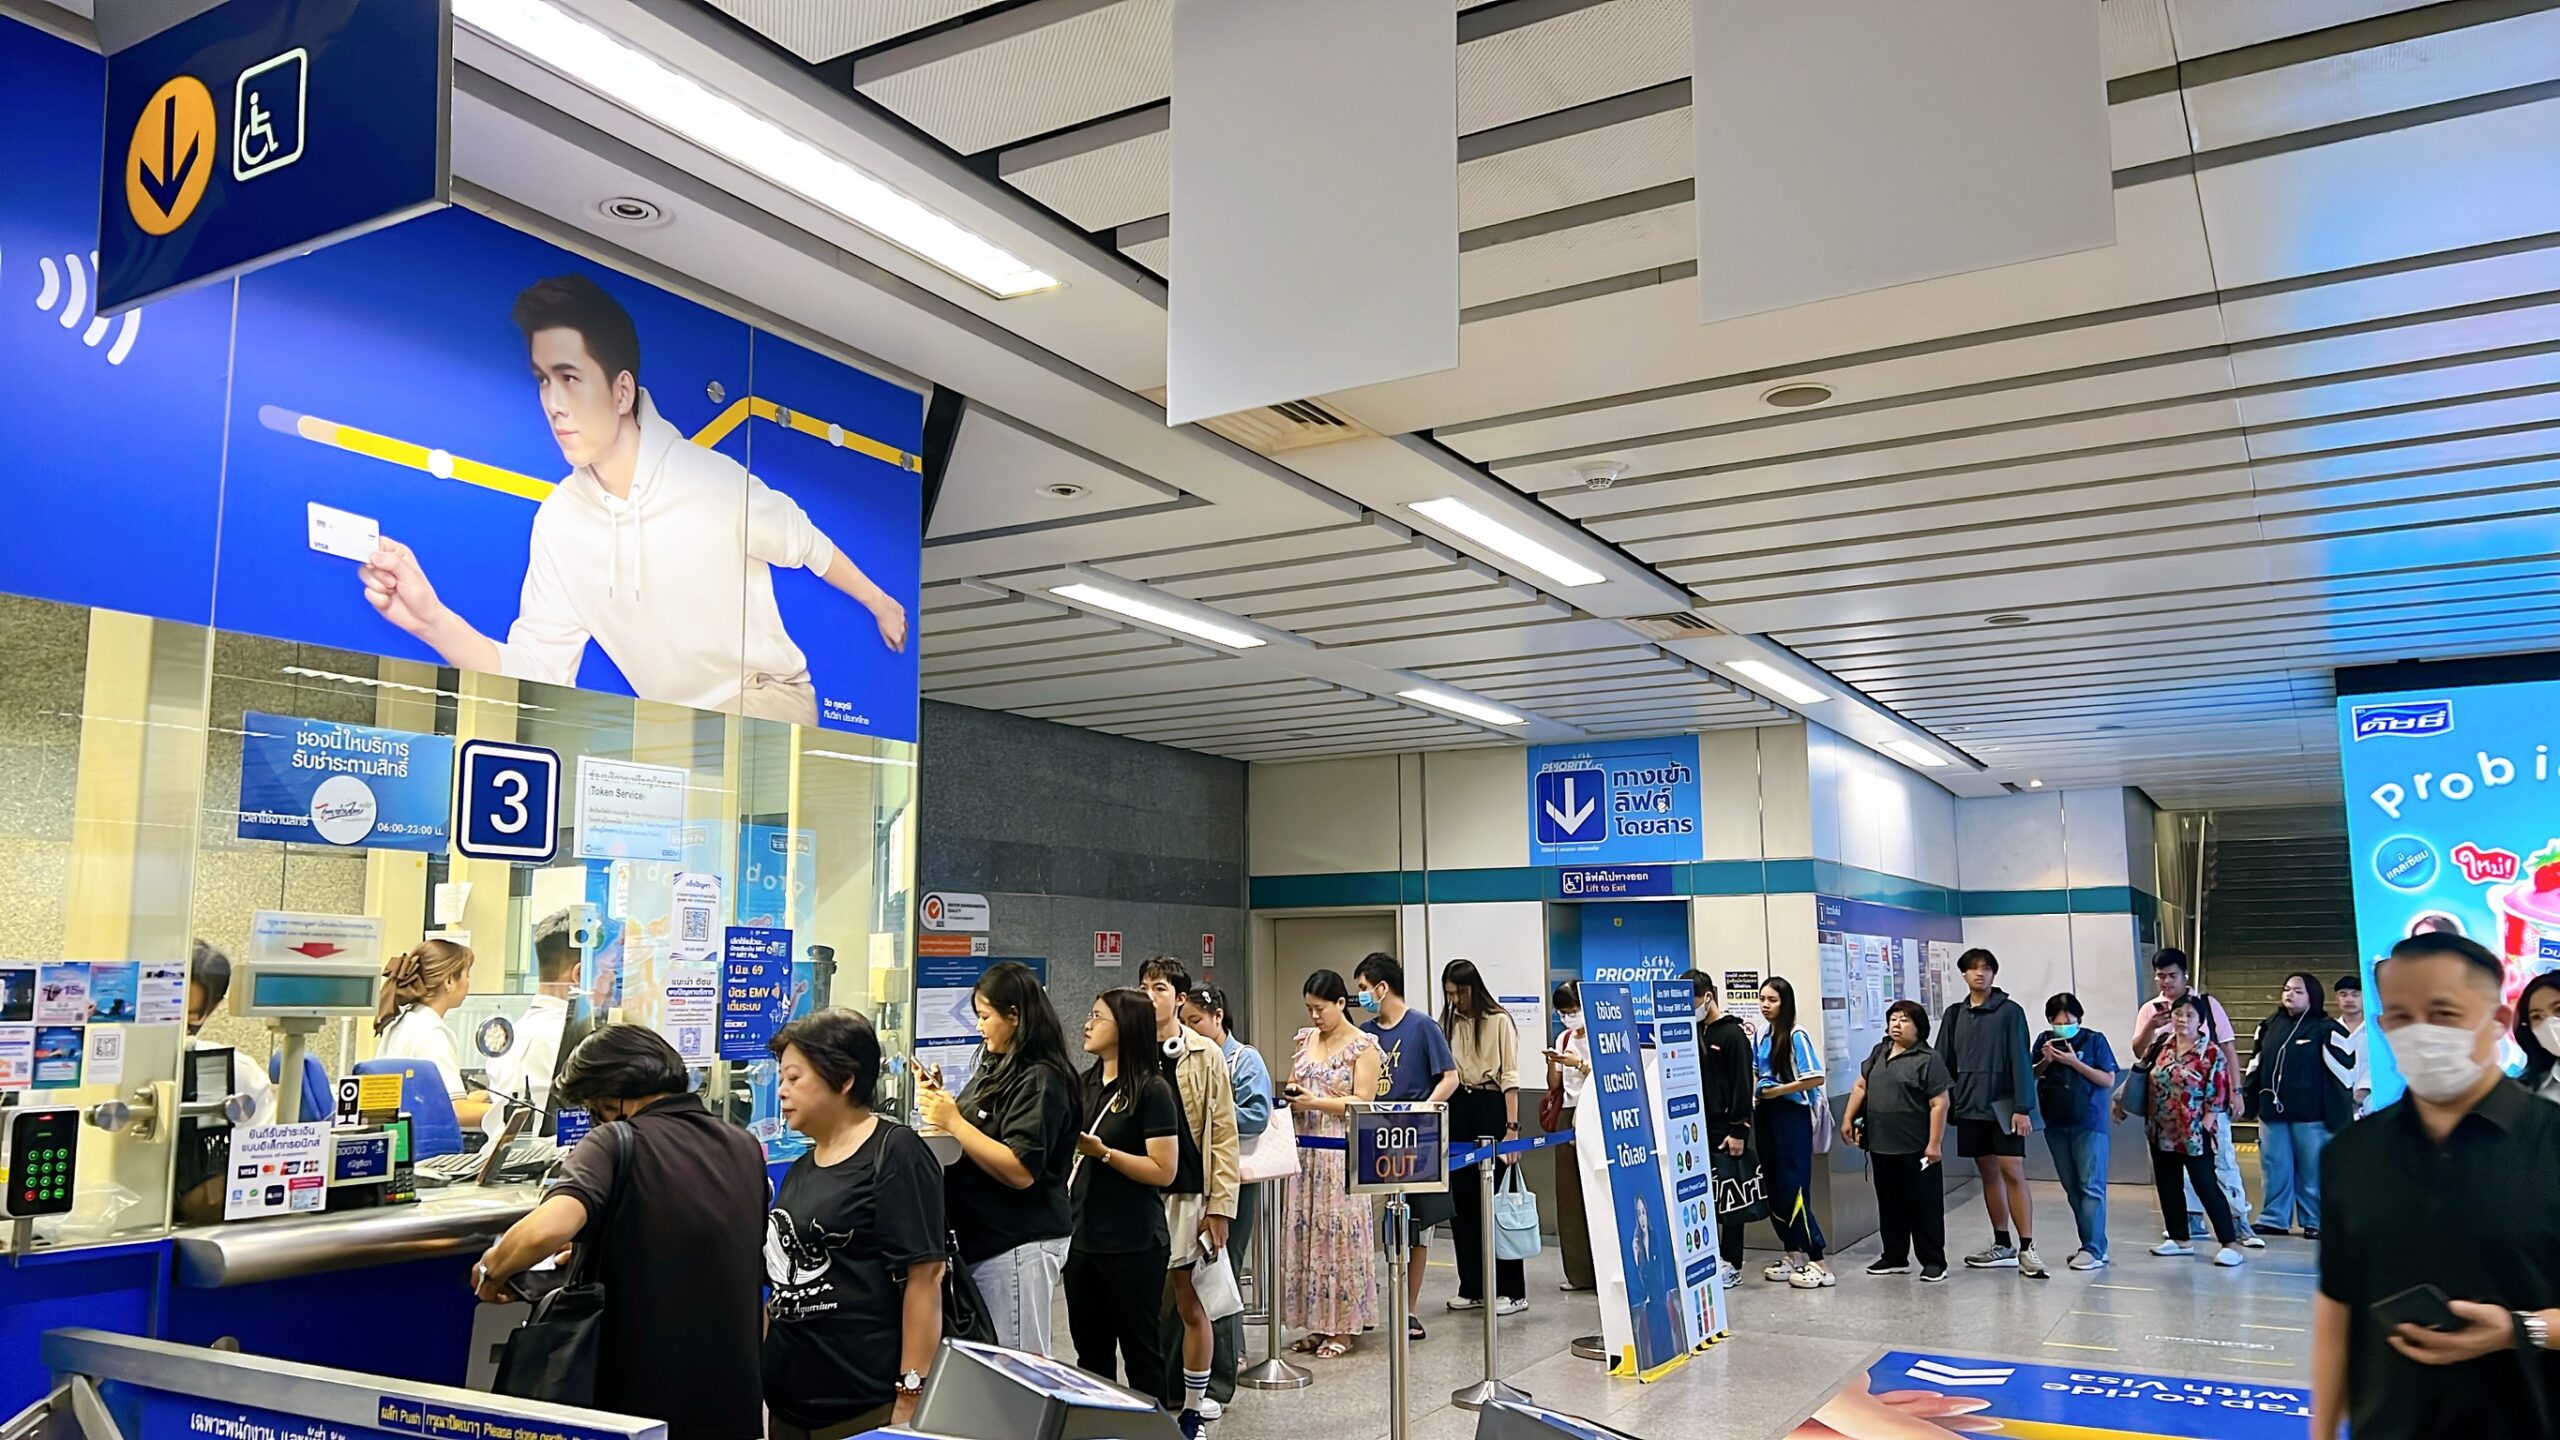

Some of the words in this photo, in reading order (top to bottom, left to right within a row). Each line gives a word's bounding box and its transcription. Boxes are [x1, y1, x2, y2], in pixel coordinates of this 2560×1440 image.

[292, 749, 409, 778] รับชำระตามสิทธิ์
[1612, 761, 1692, 787] ทางเข้า
[490, 769, 529, 834] 3
[1614, 787, 1673, 813] ลิฟต์
[377, 823, 432, 836] 06:00-23:00
[435, 827, 444, 836] น.
[1615, 817, 1693, 837] โดยสาร
[2386, 849, 2430, 881] แคลเซียม
[2462, 850, 2512, 879] ใหม่!
[1585, 870, 1648, 882] ลิฟต์ไปทางออก
[1586, 884, 1599, 893] Lift
[1612, 884, 1627, 892] Exit
[974, 942, 986, 952] SGS
[729, 964, 733, 975] 1
[752, 965, 764, 975] 69
[1595, 968, 1675, 982] PRIORITY
[728, 986, 747, 998] บัตร
[749, 987, 769, 998] EMV
[1595, 1001, 1622, 1020] ใช้บัตร
[1598, 1033, 1622, 1055] EMV
[1603, 1065, 1638, 1093] แตะเข้า
[1611, 1107, 1641, 1131] MRT
[249, 1126, 315, 1139] ยินดีรับชำระเงิน
[1376, 1127, 1417, 1149] ออก
[1617, 1142, 1647, 1169] ได้เลย
[240, 1168, 256, 1176] VISA
[1376, 1155, 1418, 1178] OUT
[2041, 1381, 2140, 1399] ride
[2152, 1393, 2208, 1406] to
[2183, 1383, 2300, 1402] with
[190, 1411, 276, 1440] เฉพาะพนักงาน
[483, 1423, 513, 1438] Please
